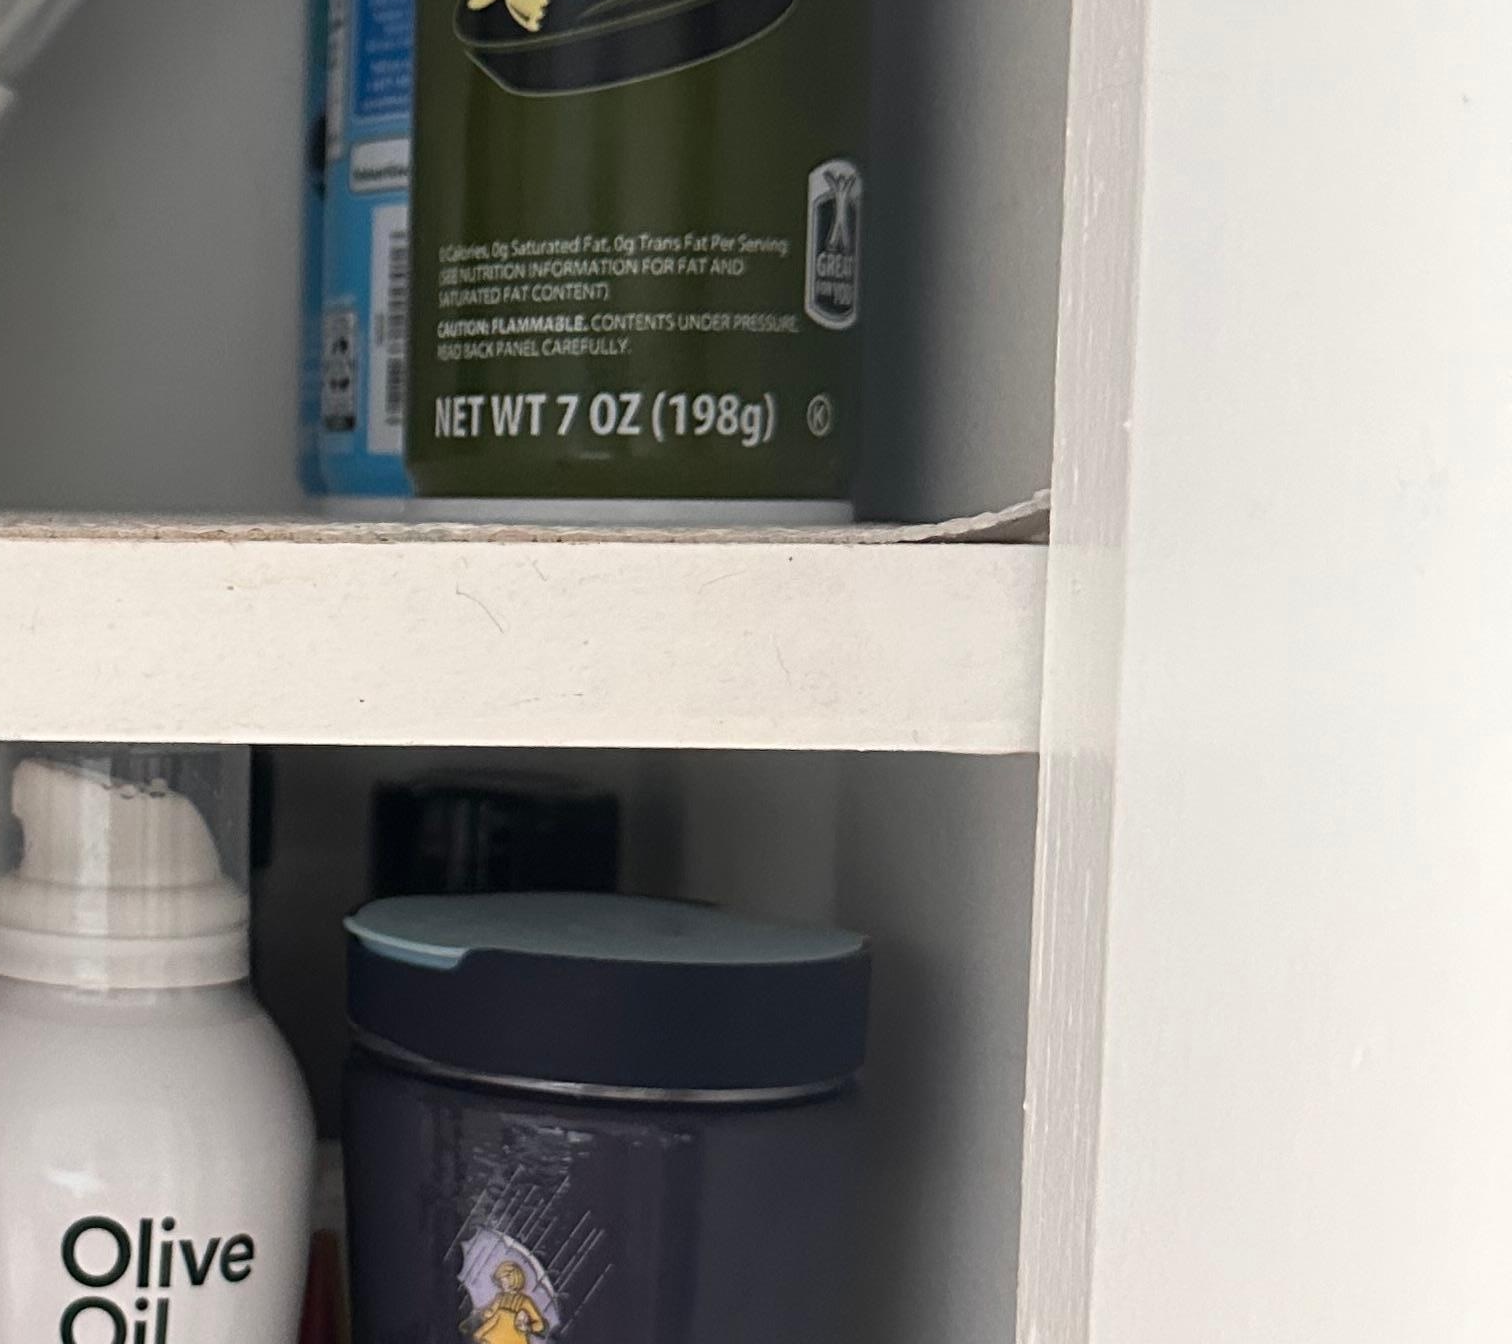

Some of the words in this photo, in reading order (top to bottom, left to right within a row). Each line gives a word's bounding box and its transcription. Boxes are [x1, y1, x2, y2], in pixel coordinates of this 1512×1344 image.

[511, 235, 581, 257] Saturated
[639, 232, 680, 252] Trans
[684, 232, 708, 252] Fat
[711, 233, 734, 252] Per
[460, 263, 525, 283] NUTRITION
[528, 257, 637, 279] INFORMATION
[642, 257, 675, 276] FOR
[678, 257, 705, 275] FAT
[710, 257, 745, 275] AND
[503, 284, 528, 304] FAT
[591, 312, 677, 332] CONTENTS
[679, 313, 730, 332] UNDER
[497, 339, 537, 357] PANEL
[435, 395, 487, 438] NET
[491, 394, 547, 437] WT
[556, 394, 580, 437] 7
[590, 392, 643, 436] OZ
[652, 390, 776, 449] (198g)
[61, 1215, 255, 1288] Olive
